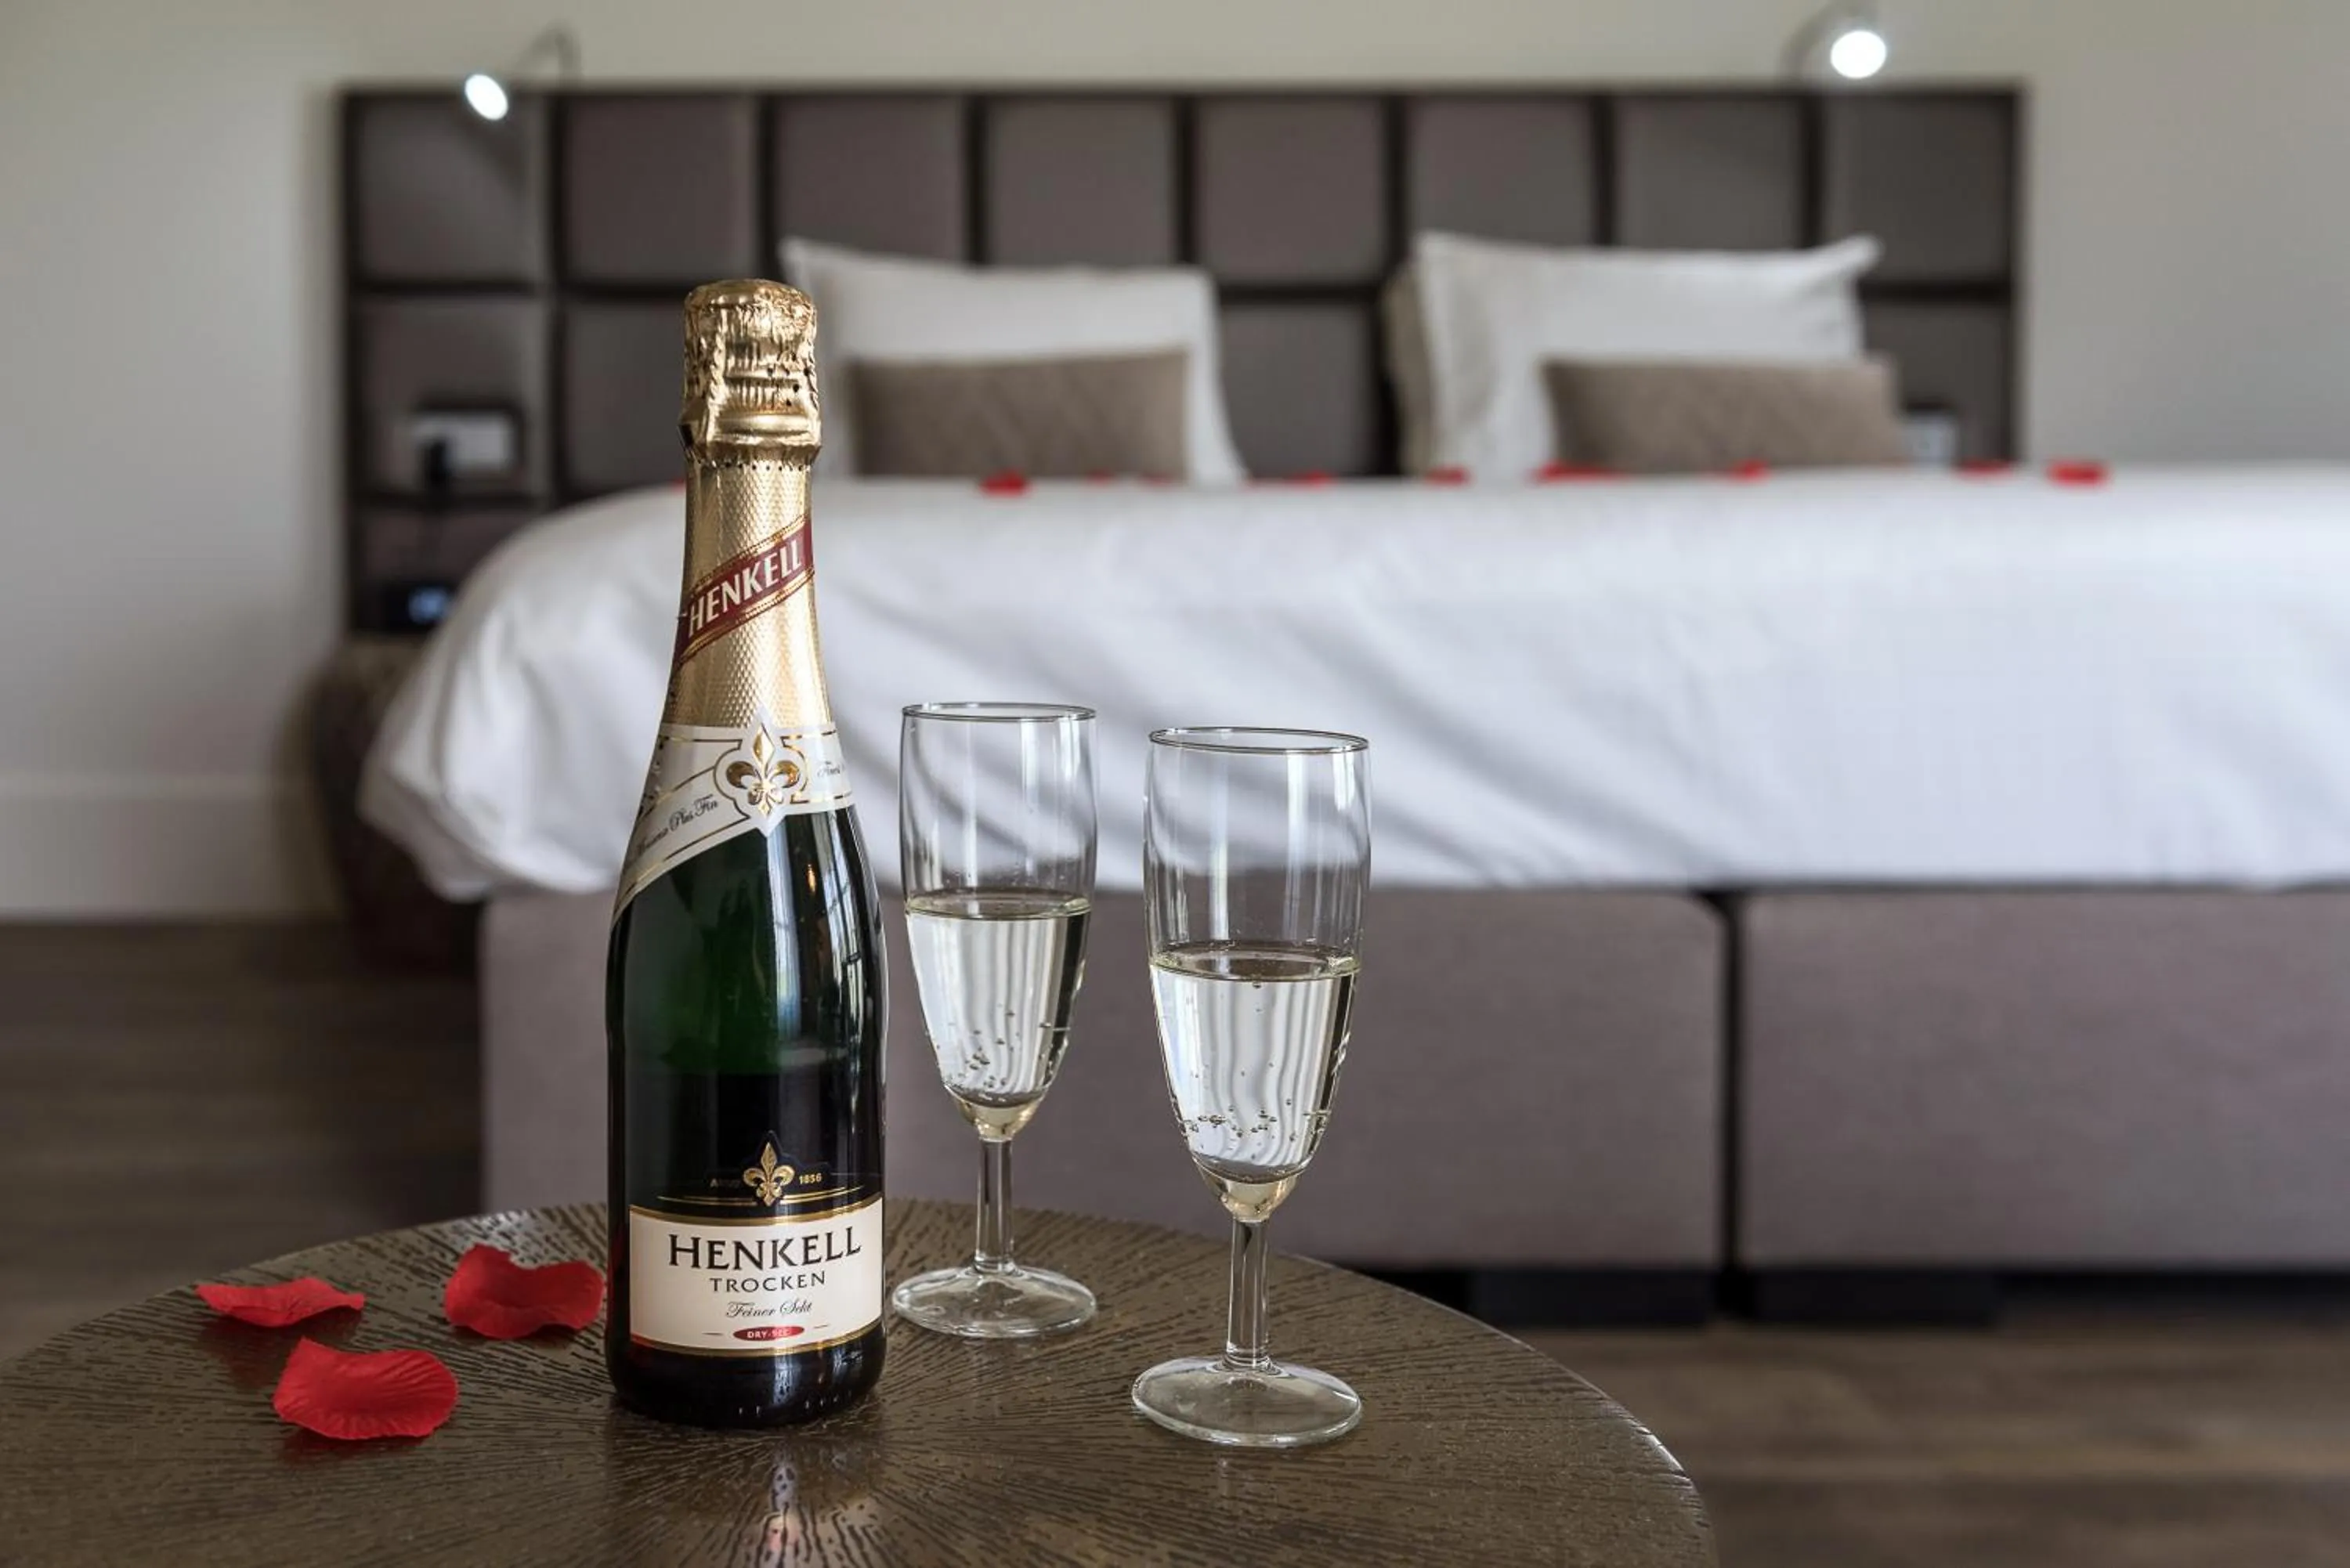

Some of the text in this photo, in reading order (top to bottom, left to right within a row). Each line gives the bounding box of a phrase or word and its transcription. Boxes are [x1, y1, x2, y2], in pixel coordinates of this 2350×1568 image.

[689, 539, 802, 638] HENKELL
[668, 1226, 861, 1270] HENKELL
[710, 1270, 825, 1292] TROCKEN
[725, 1298, 812, 1317] Feiner Sekt
